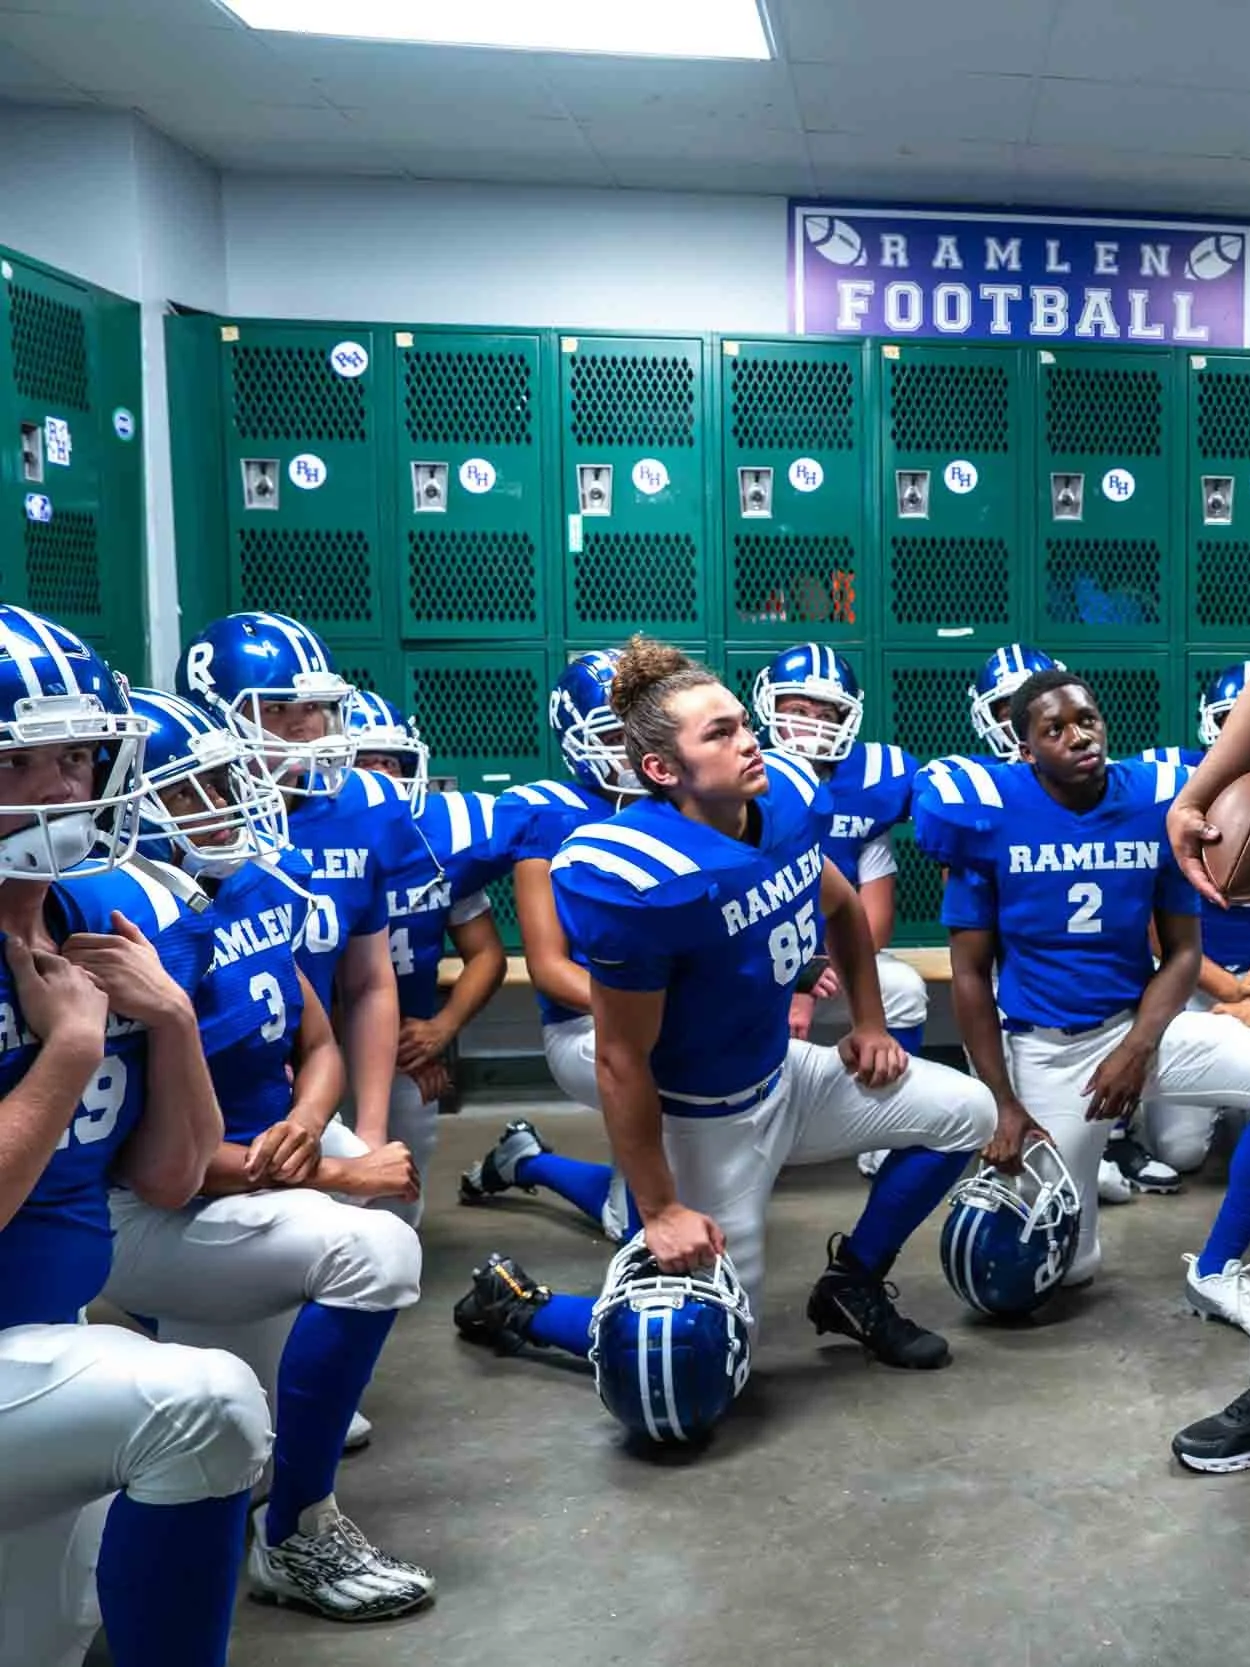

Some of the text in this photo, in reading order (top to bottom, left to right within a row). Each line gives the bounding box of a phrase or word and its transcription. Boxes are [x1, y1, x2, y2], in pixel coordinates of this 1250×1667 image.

[880, 233, 1171, 278] RAMLEN
[836, 280, 1209, 341] FOOTBALL
[187, 642, 216, 691] R
[301, 849, 368, 878] LEN
[1008, 841, 1160, 874] RAMLEN
[386, 882, 452, 917] LEN
[721, 843, 822, 936] RAMLEN
[1067, 882, 1102, 933] 2
[305, 895, 339, 953] 0
[768, 900, 817, 986] 85
[249, 971, 286, 1043] 3
[56, 1055, 127, 1150] 9
